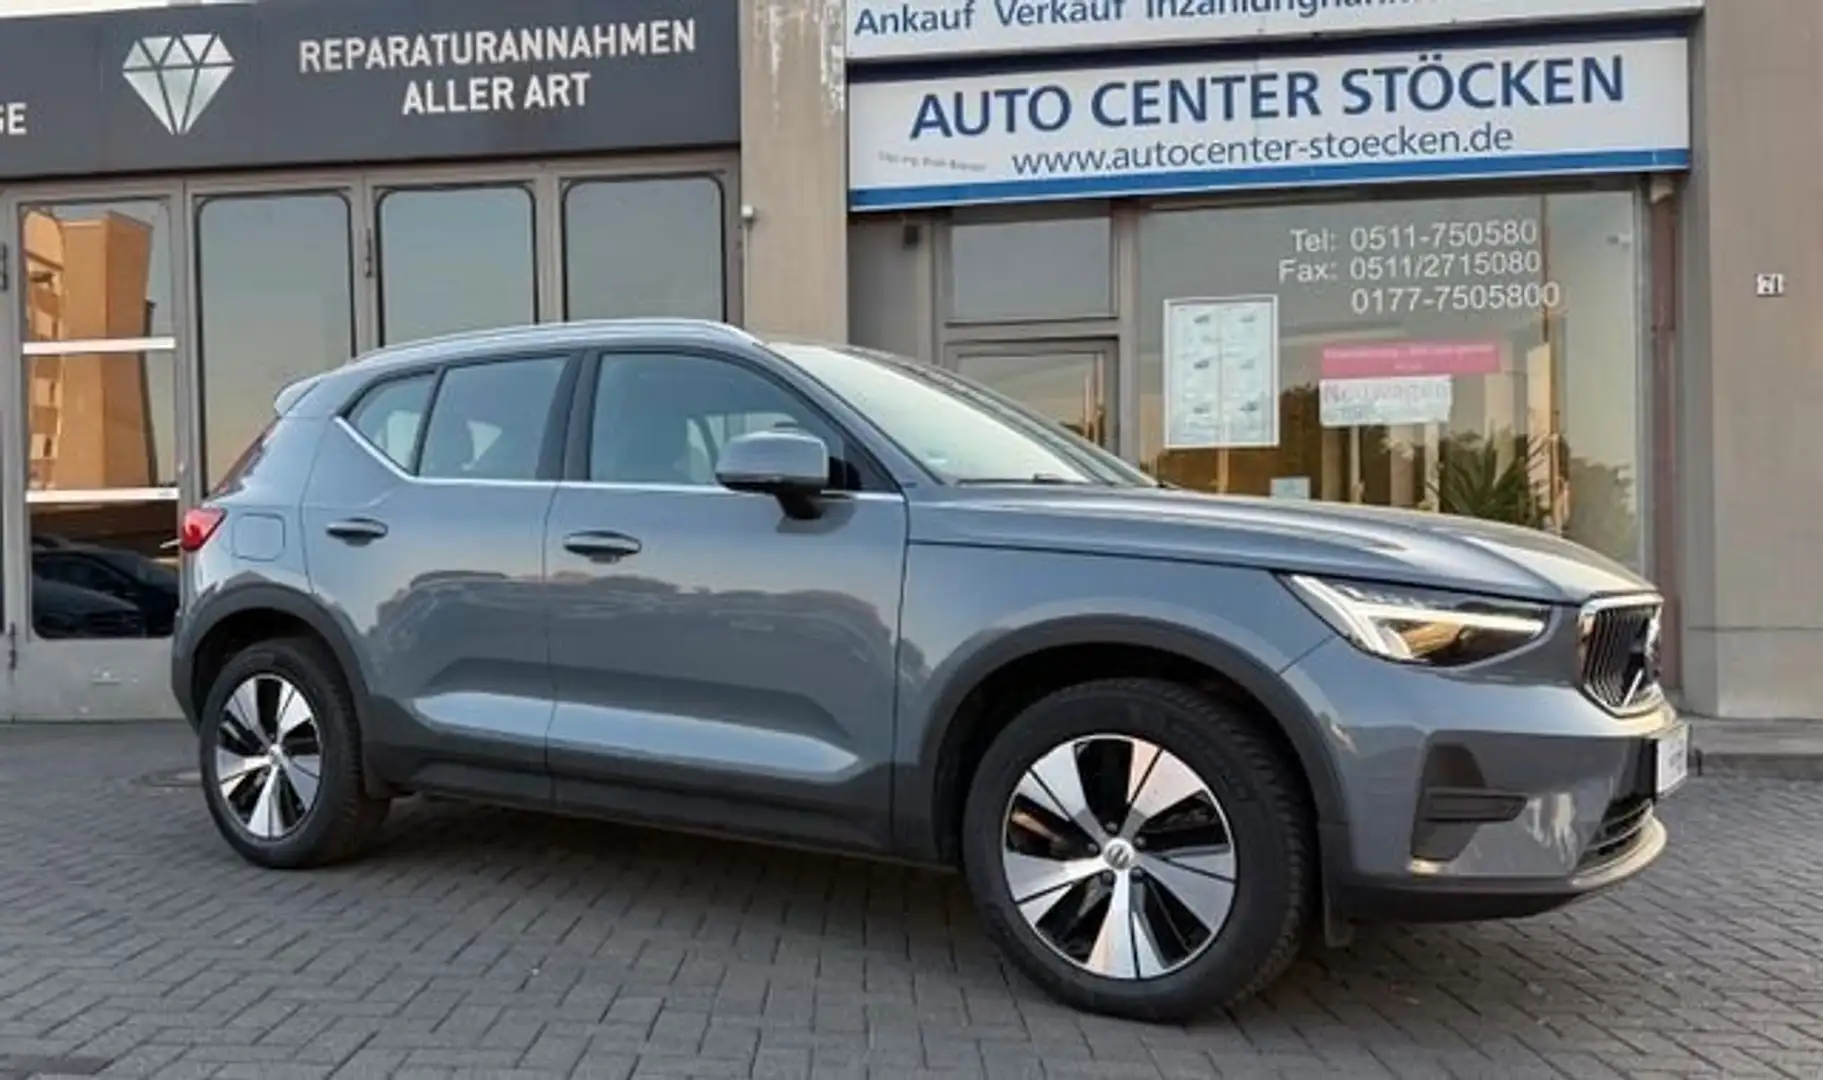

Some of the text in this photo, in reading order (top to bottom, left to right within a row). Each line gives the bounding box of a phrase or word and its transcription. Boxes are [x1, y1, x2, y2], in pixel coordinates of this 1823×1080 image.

[853, 0, 1412, 36] Ankauf Verkauf Inzahung
[299, 18, 696, 74] REPARATURANNAHMEN
[402, 72, 592, 116] ALLER ART
[910, 53, 1624, 140] AUTO CENTER STÖCKEN
[0, 102, 28, 135] E
[1011, 121, 1514, 175] www.autocenter-stoecken.de
[1289, 219, 1538, 253] Tel: 0511-750580
[1279, 249, 1541, 284] Fax: 0511/2715080
[1350, 281, 1560, 316] 0177-7505800
